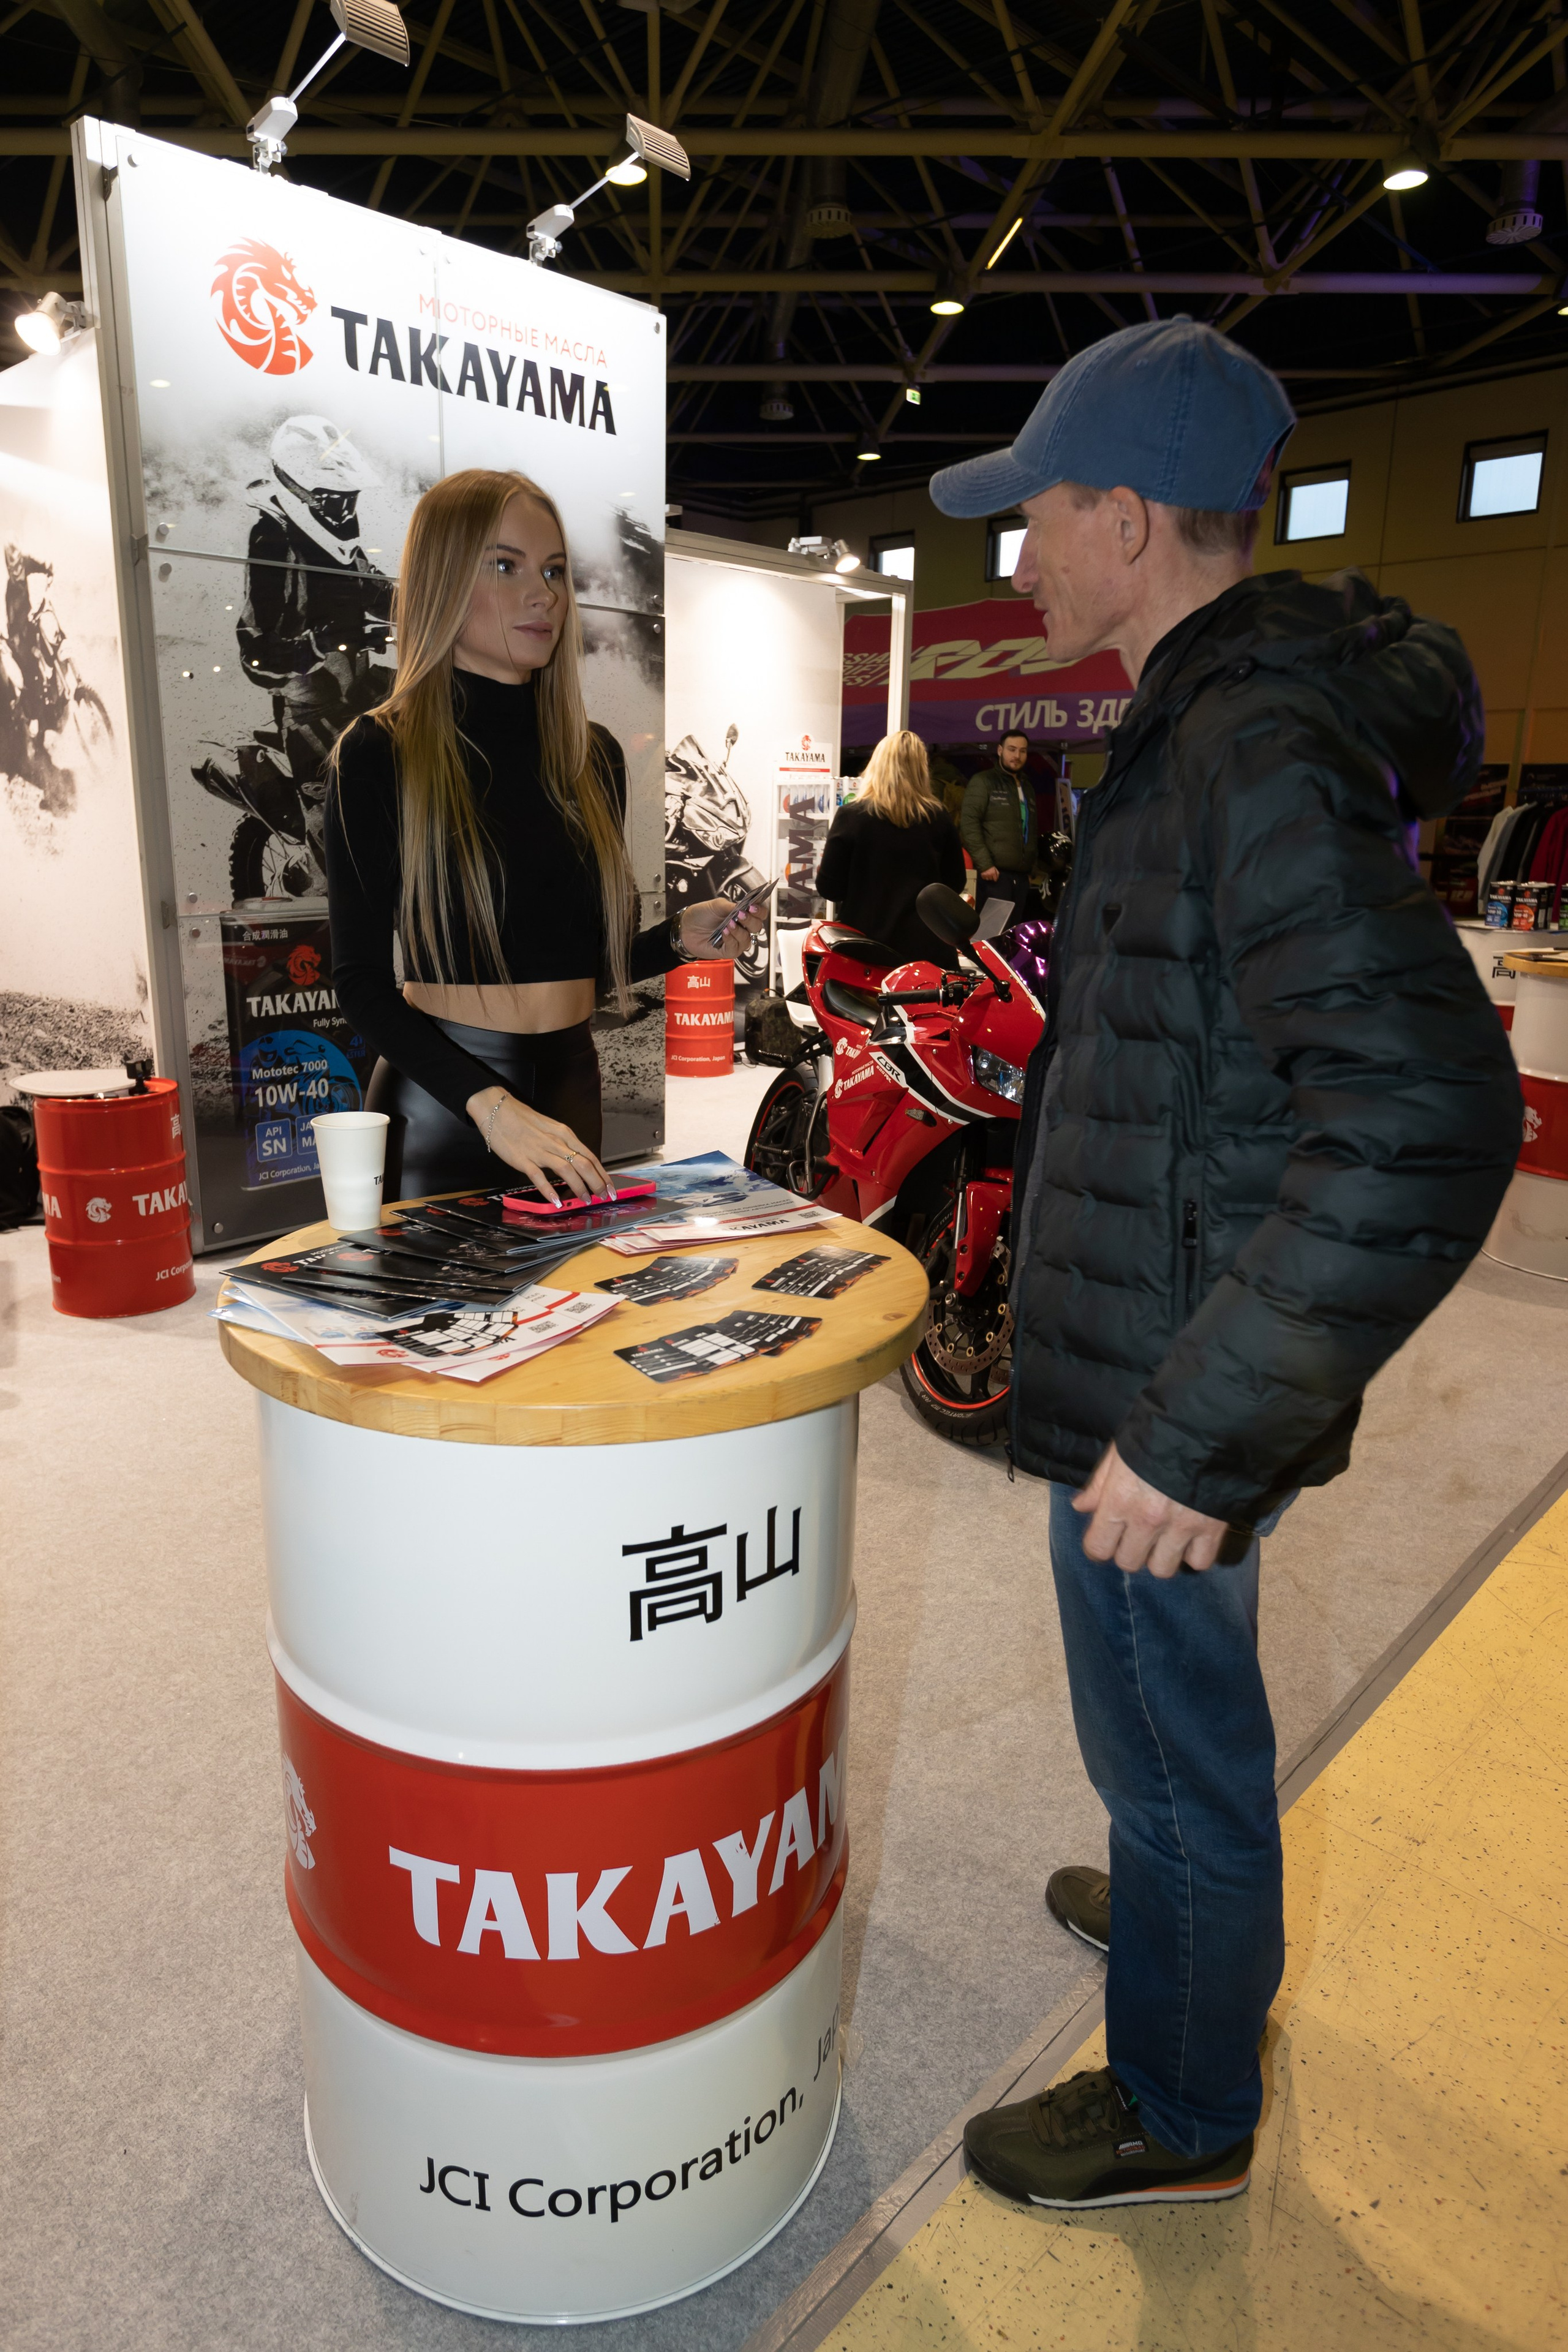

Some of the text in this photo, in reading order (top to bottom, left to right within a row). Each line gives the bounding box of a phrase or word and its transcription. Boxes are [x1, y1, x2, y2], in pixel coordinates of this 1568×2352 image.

[420, 293, 608, 369] МОТОРНЫЕ МАСЛА
[331, 305, 617, 436] TAKAYAMA
[975, 699, 1068, 732] СТИЛЬ
[785, 752, 826, 763] TAKAYAMA
[687, 975, 710, 989] 高山
[313, 1017, 330, 1028] Fully
[252, 1059, 328, 1080] Mototec 7000
[843, 1065, 874, 1091] TAKAYAMA
[876, 1056, 900, 1083] CBR
[255, 1077, 329, 1108] 10W-40
[265, 1126, 282, 1137] API
[262, 1137, 287, 1156] SN
[258, 1172, 269, 1181] JCI
[270, 1164, 312, 1178] Corporation,
[156, 1268, 170, 1281] JCI
[622, 1505, 802, 1642] 高山
[420, 2156, 491, 2212] JCI
[508, 2086, 804, 2223] Corporation,
